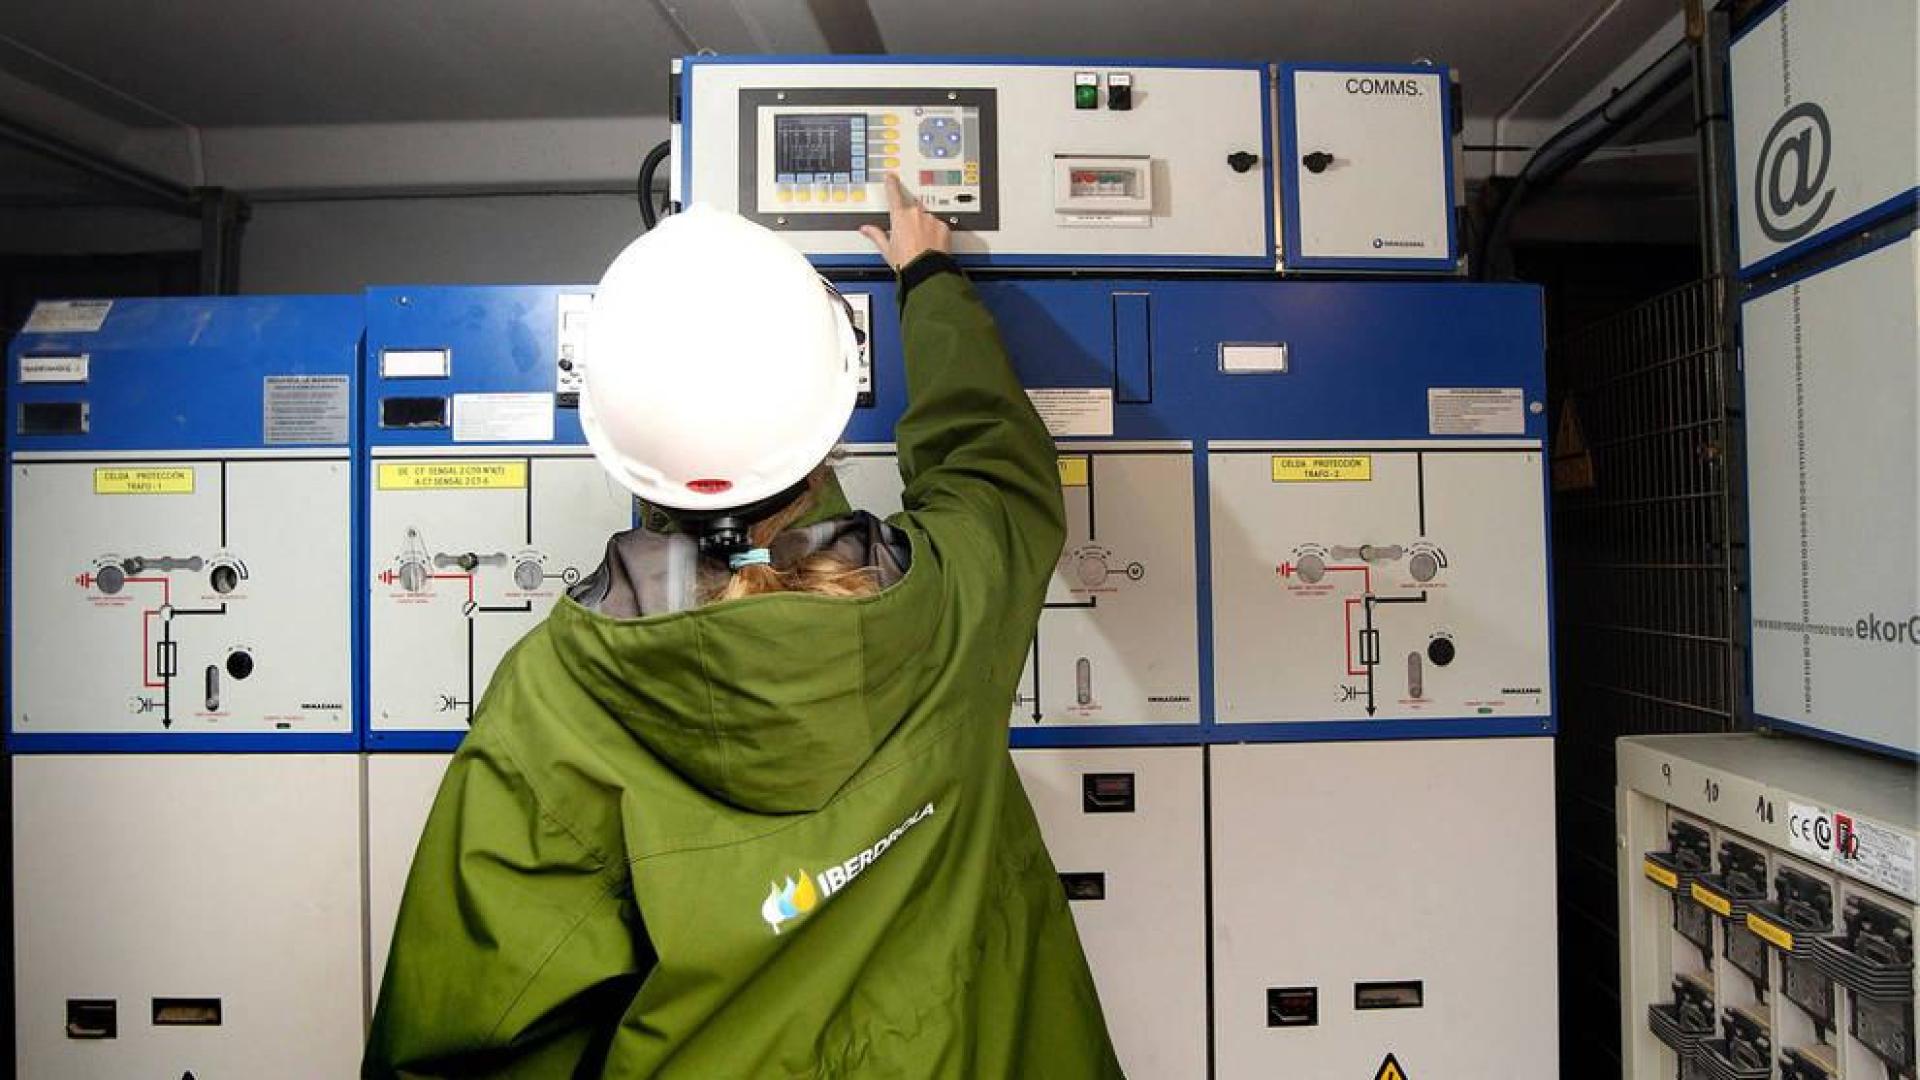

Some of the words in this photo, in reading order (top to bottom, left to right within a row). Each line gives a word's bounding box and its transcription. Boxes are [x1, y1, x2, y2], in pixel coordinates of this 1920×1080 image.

[1346, 78, 1423, 96] COMMS.
[1661, 763, 1671, 786] 9
[1704, 777, 1719, 804] 10
